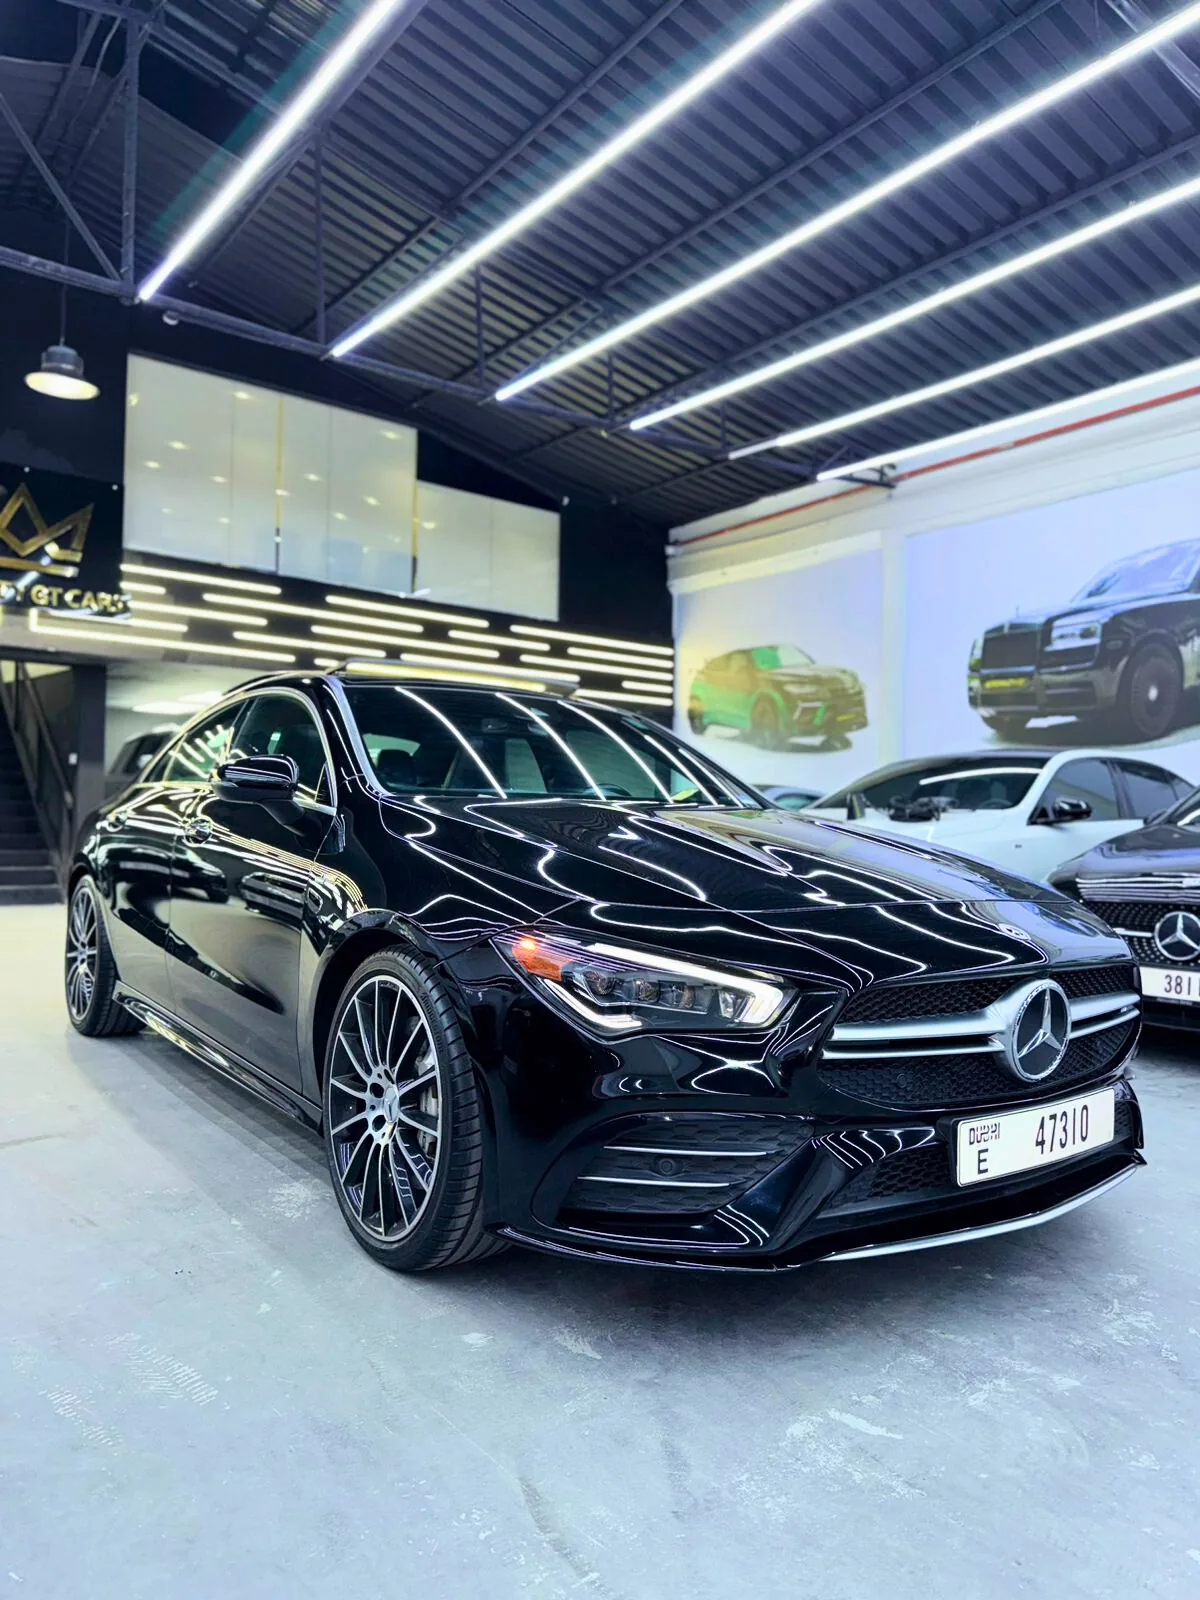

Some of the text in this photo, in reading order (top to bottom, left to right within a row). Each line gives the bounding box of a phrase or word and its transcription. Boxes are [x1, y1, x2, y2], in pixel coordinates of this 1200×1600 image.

[30, 584, 63, 607] GT
[1035, 1104, 1089, 1155] 47310
[977, 1148, 989, 1175] E
